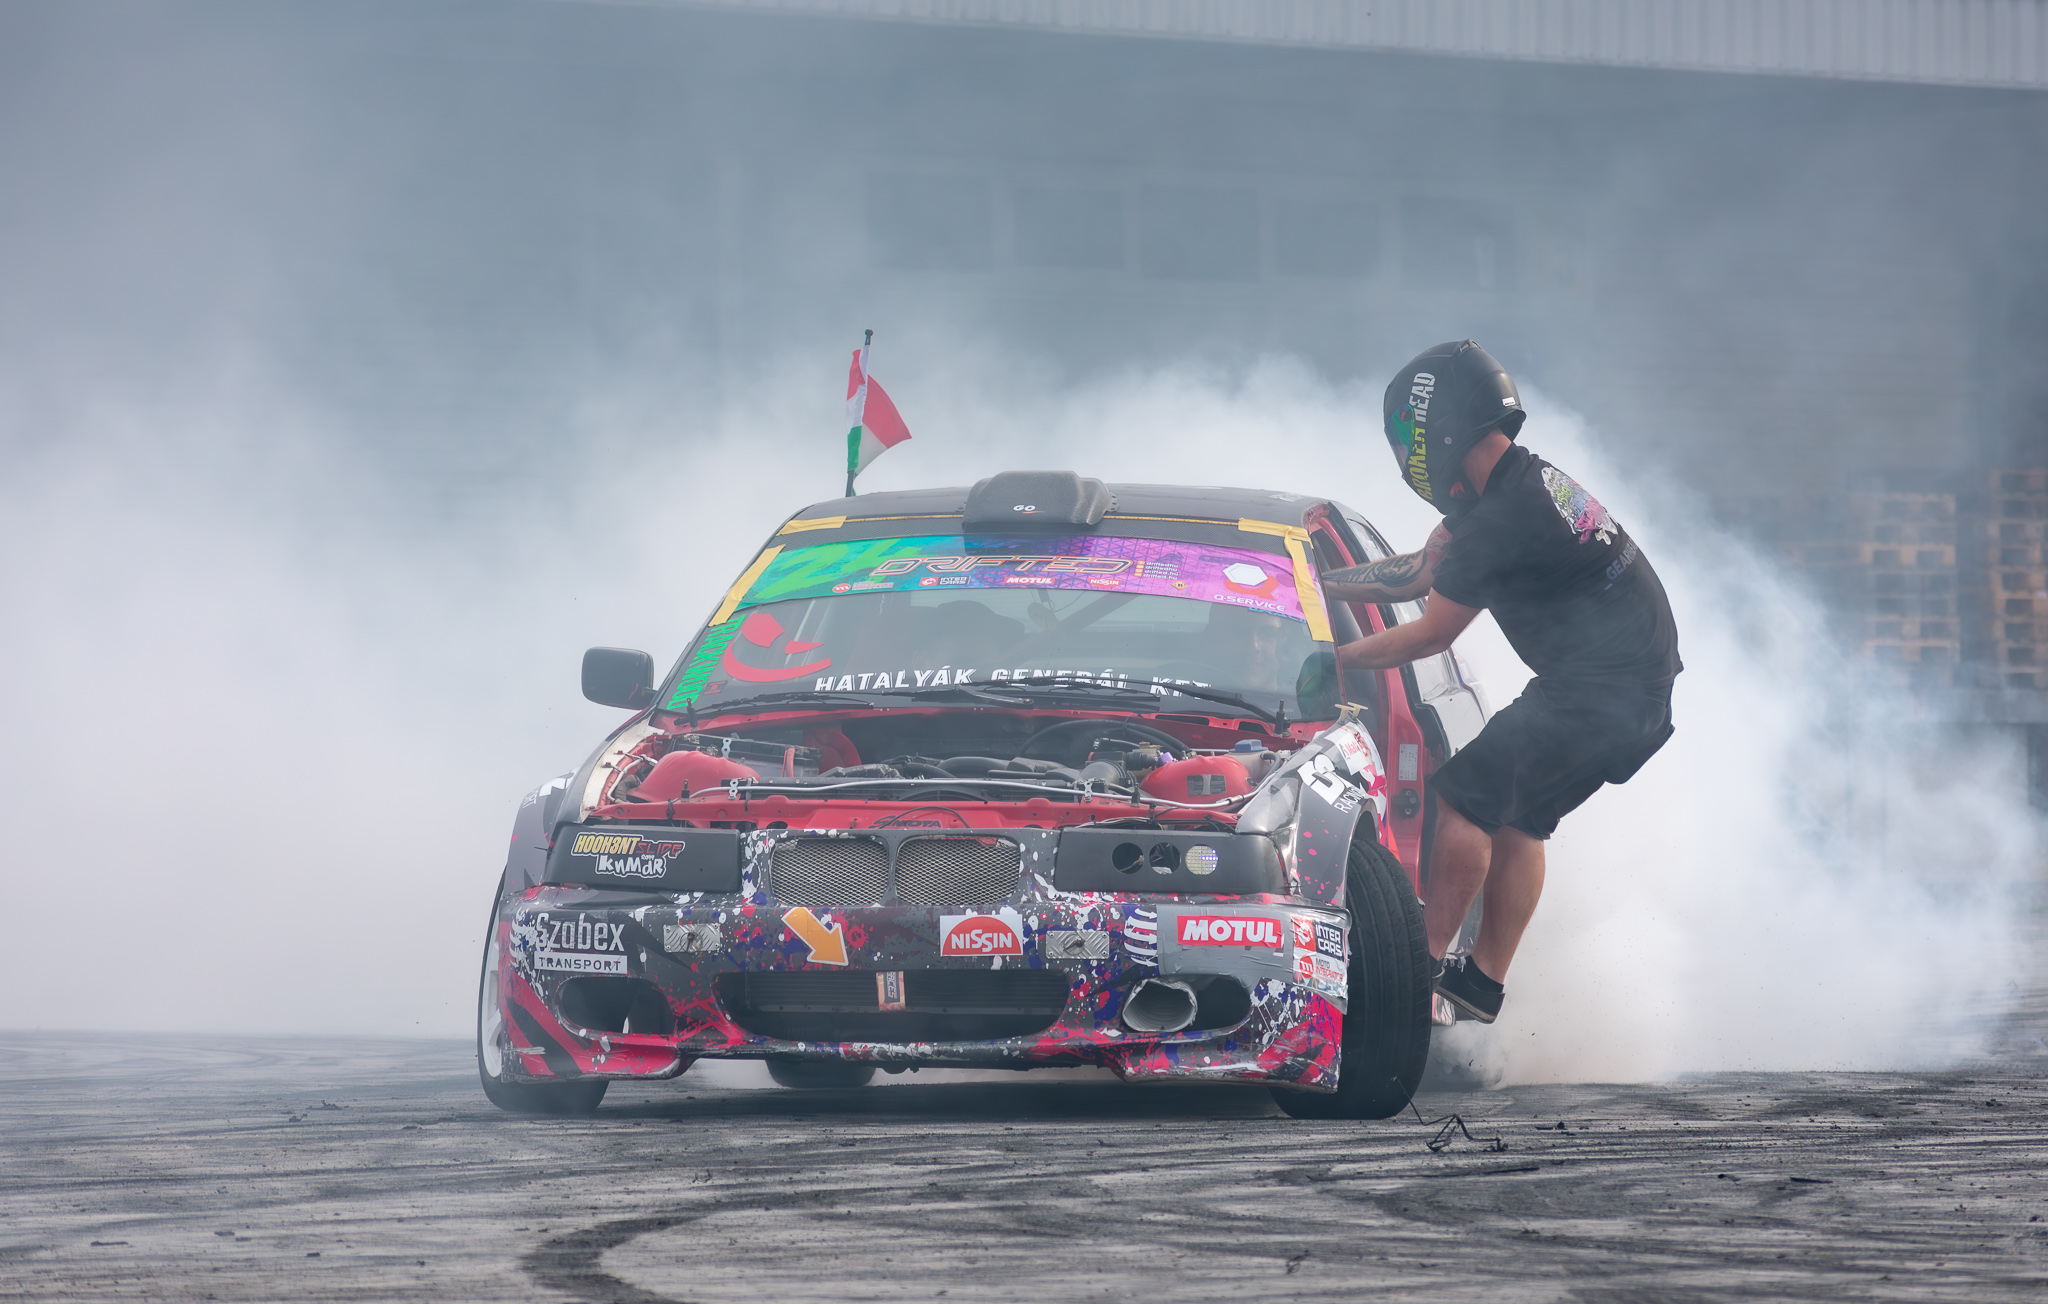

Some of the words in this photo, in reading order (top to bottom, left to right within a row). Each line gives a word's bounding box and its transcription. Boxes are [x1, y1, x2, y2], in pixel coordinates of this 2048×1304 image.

[868, 555, 1134, 577] DRIFTED
[1006, 577, 1053, 585] MOTUL
[666, 614, 747, 710] TRACKWOOD
[814, 665, 977, 692] HATALYÁK
[535, 912, 625, 952] Szabex
[951, 929, 1013, 953] NISSIN
[1182, 919, 1278, 944] MOTUL
[1315, 924, 1341, 944] INTER
[1317, 937, 1343, 957] CARS
[538, 956, 621, 971] TRANSPORT
